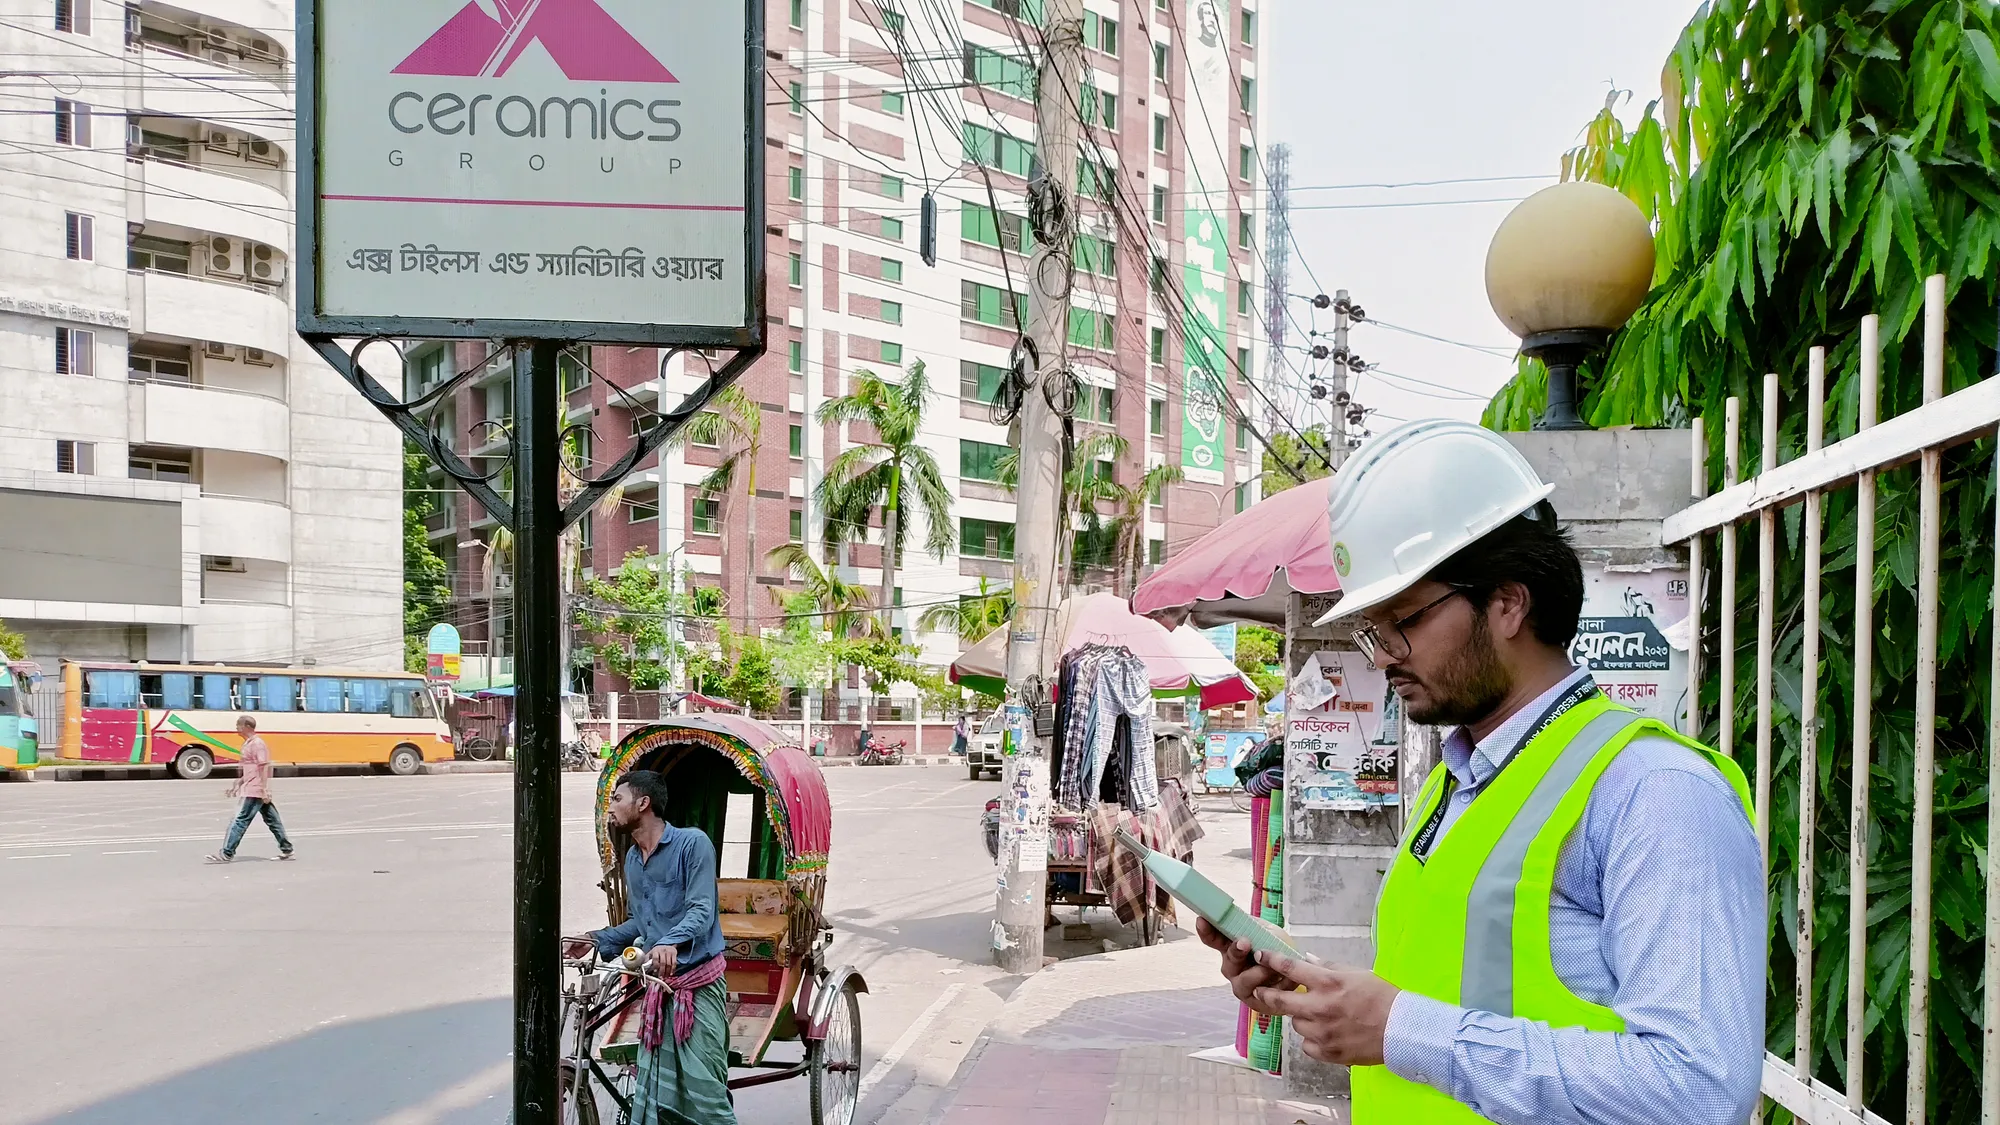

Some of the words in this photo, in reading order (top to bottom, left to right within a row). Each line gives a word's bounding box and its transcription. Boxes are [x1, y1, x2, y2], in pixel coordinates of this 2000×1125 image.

[388, 88, 682, 142] ceramics
[399, 243, 480, 275] টাইলস
[536, 245, 646, 279] স্যানিটারি
[1603, 660, 1633, 669] ইফতার
[1635, 659, 1666, 669] মাহফিল
[1645, 645, 1668, 657] ২০২৩
[1617, 683, 1658, 703] রহমান
[1413, 814, 1440, 856] USTAINABLE
